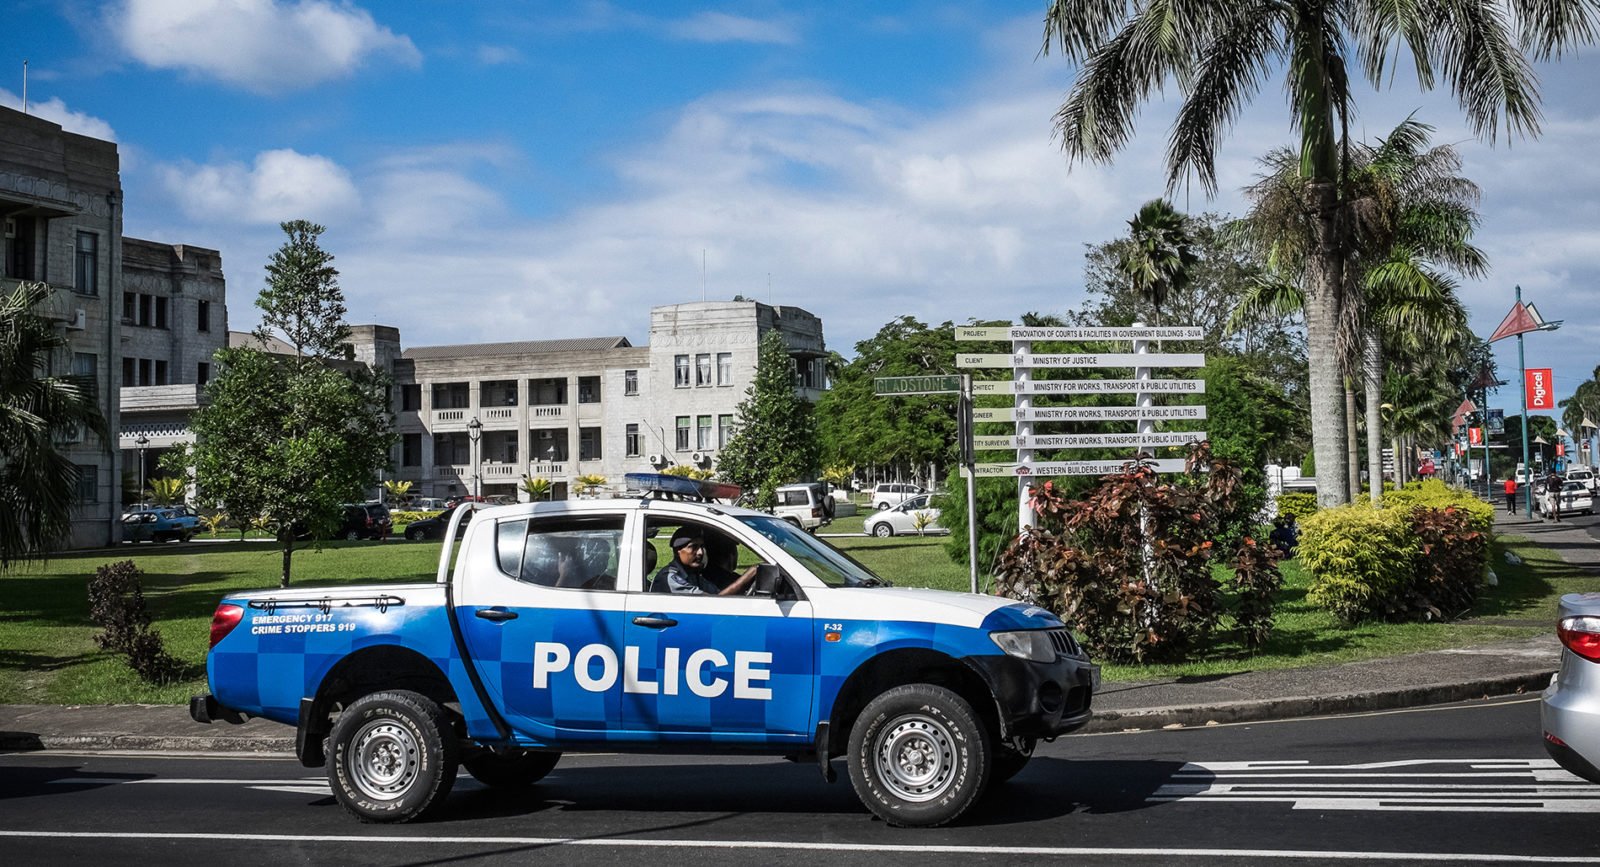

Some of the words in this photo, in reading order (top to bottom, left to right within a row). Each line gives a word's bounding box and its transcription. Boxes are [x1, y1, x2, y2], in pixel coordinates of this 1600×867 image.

[1072, 356, 1097, 364] JUSTICE
[876, 378, 948, 392] GLADSTONE
[1532, 372, 1546, 406] Digicel
[1078, 437, 1103, 445] WORKS,
[1036, 466, 1066, 474] WESTERN
[252, 615, 314, 624] EMERGENCY
[316, 614, 333, 622] 917
[252, 626, 282, 634] CRIME
[284, 624, 336, 633] STOPPERS
[338, 623, 356, 631] 919
[533, 642, 773, 700] POLICE
[376, 708, 428, 772] SILVERSTONE
[336, 743, 356, 800] SPECIAL
